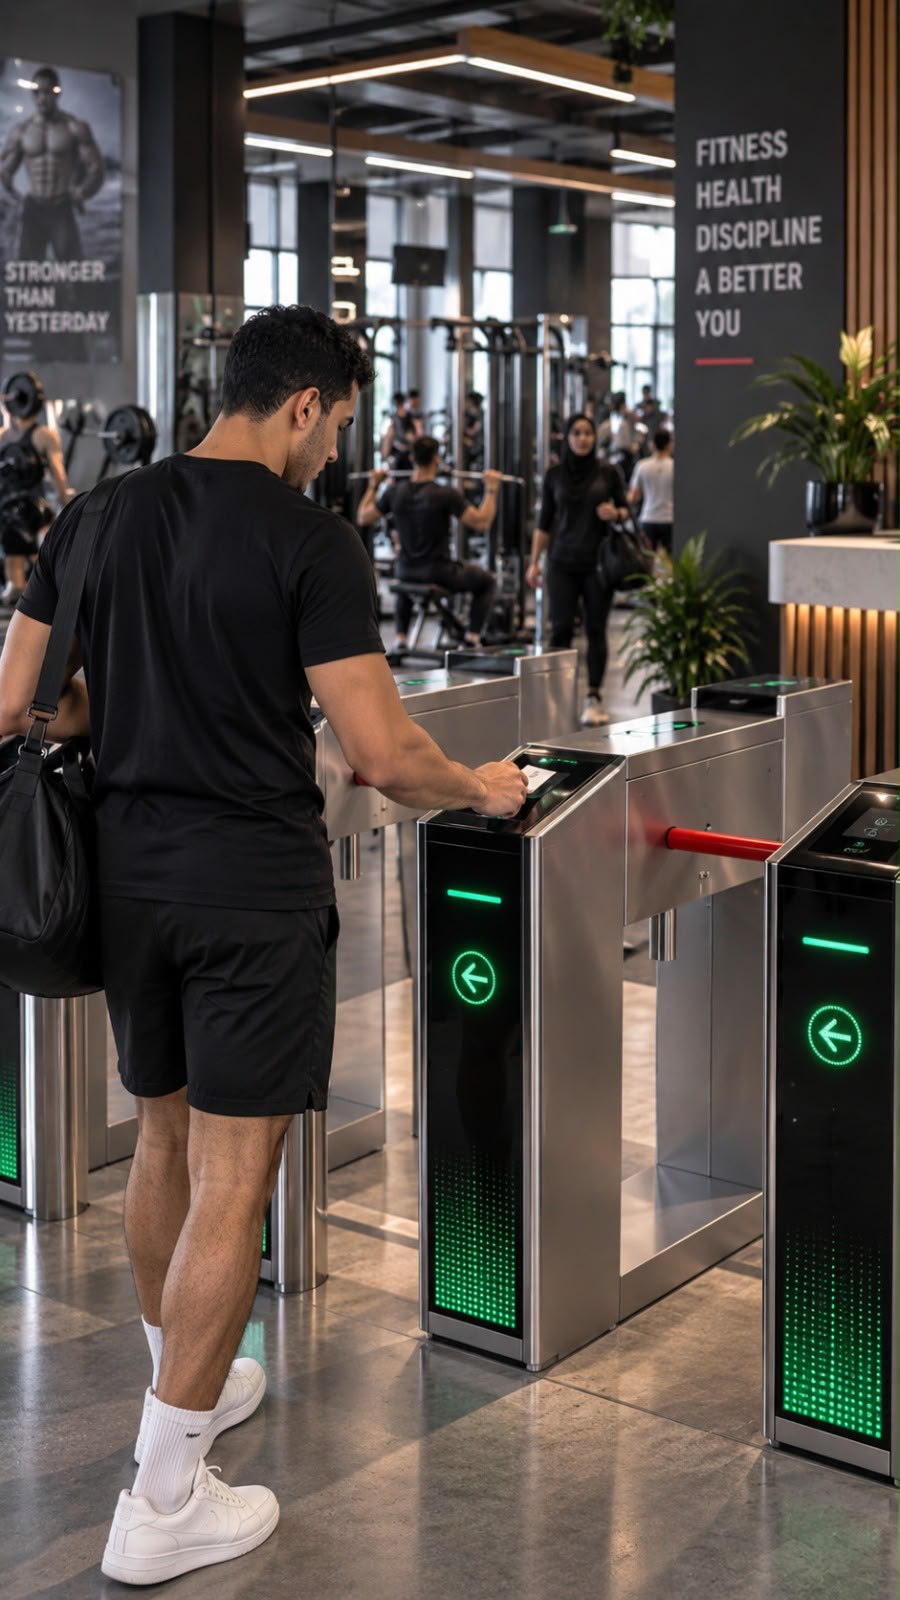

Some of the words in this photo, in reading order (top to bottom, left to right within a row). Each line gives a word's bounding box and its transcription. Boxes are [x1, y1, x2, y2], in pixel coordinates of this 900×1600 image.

[696, 129, 788, 167] FITNESS
[696, 174, 781, 209] HEALTH
[696, 215, 822, 252] DISCIPLINE
[5, 261, 105, 282] STRONGER
[695, 267, 711, 295] A
[718, 261, 803, 293] BETTER
[4, 286, 55, 307] THAN
[5, 311, 110, 333] YESTERDAY
[695, 309, 740, 338] YOU
